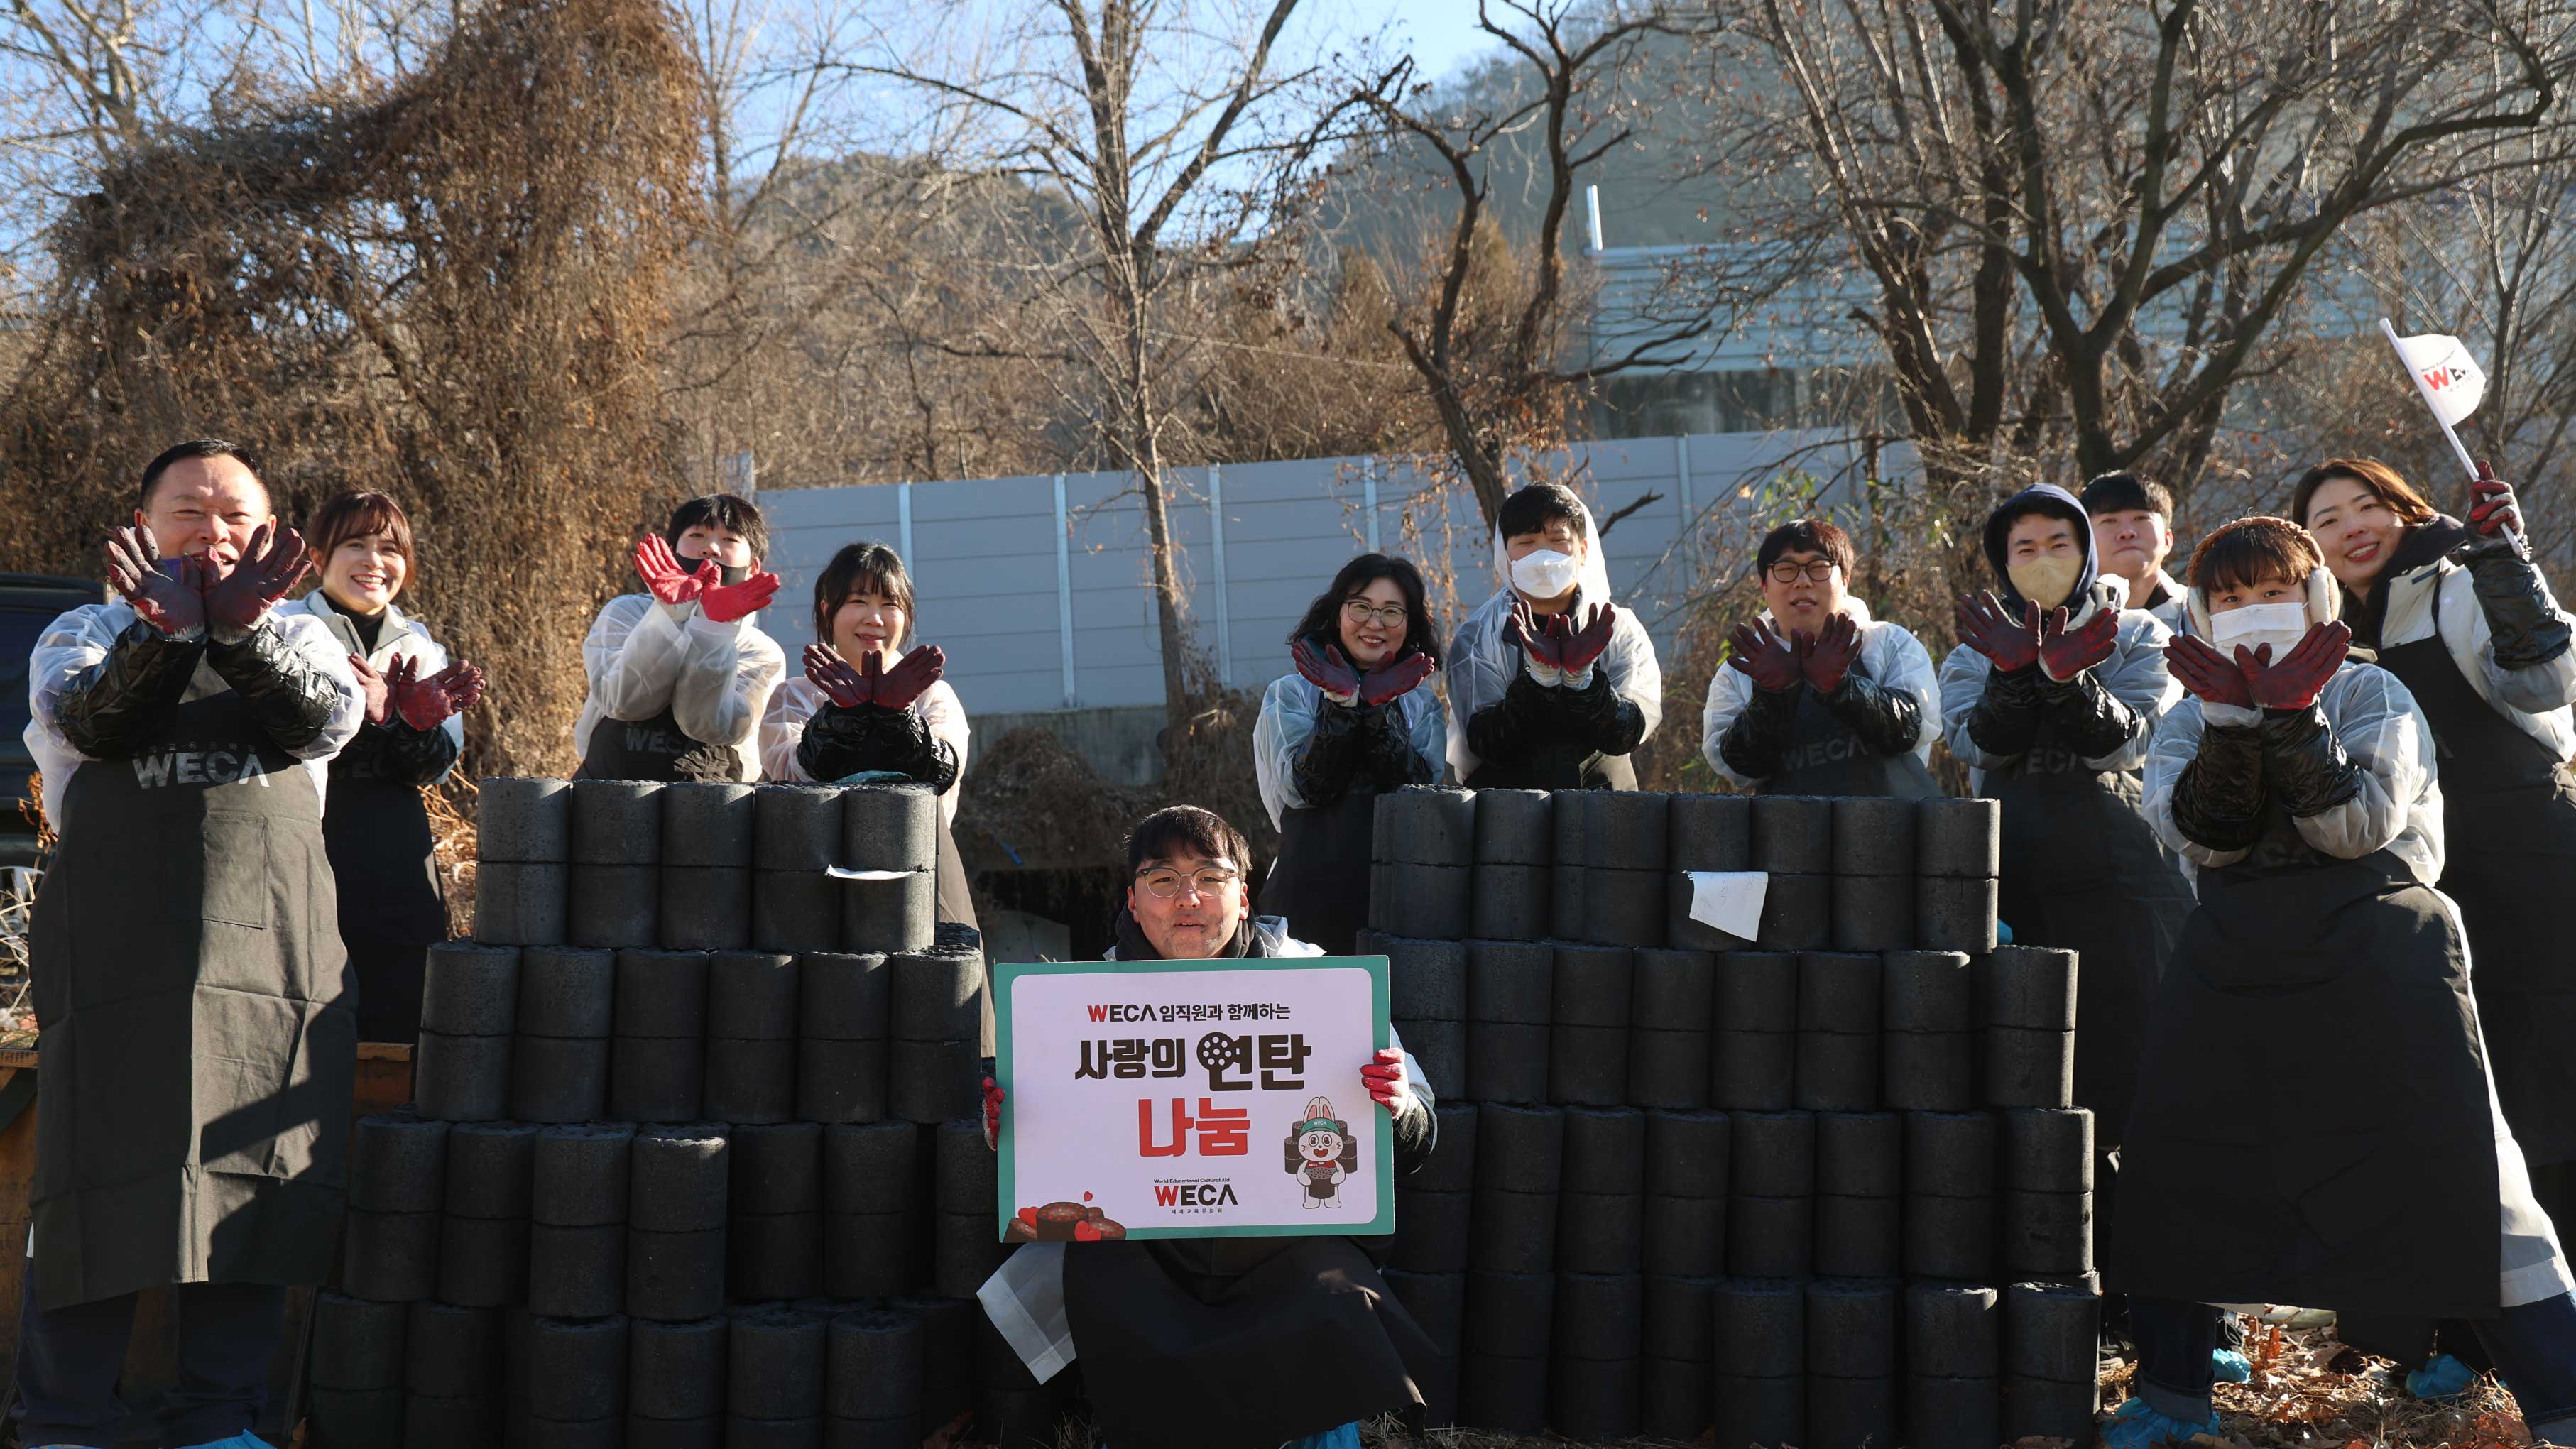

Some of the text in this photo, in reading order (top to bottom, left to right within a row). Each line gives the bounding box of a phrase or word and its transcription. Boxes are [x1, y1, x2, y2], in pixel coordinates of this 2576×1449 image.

[132, 750, 269, 790] WECA
[1087, 1002, 1291, 1022] WECA 임직원과 함께하는
[1075, 1032, 1311, 1091] 사랑의 연탄
[1138, 1097, 1250, 1157] 나눔
[1154, 1184, 1238, 1206] WECA
